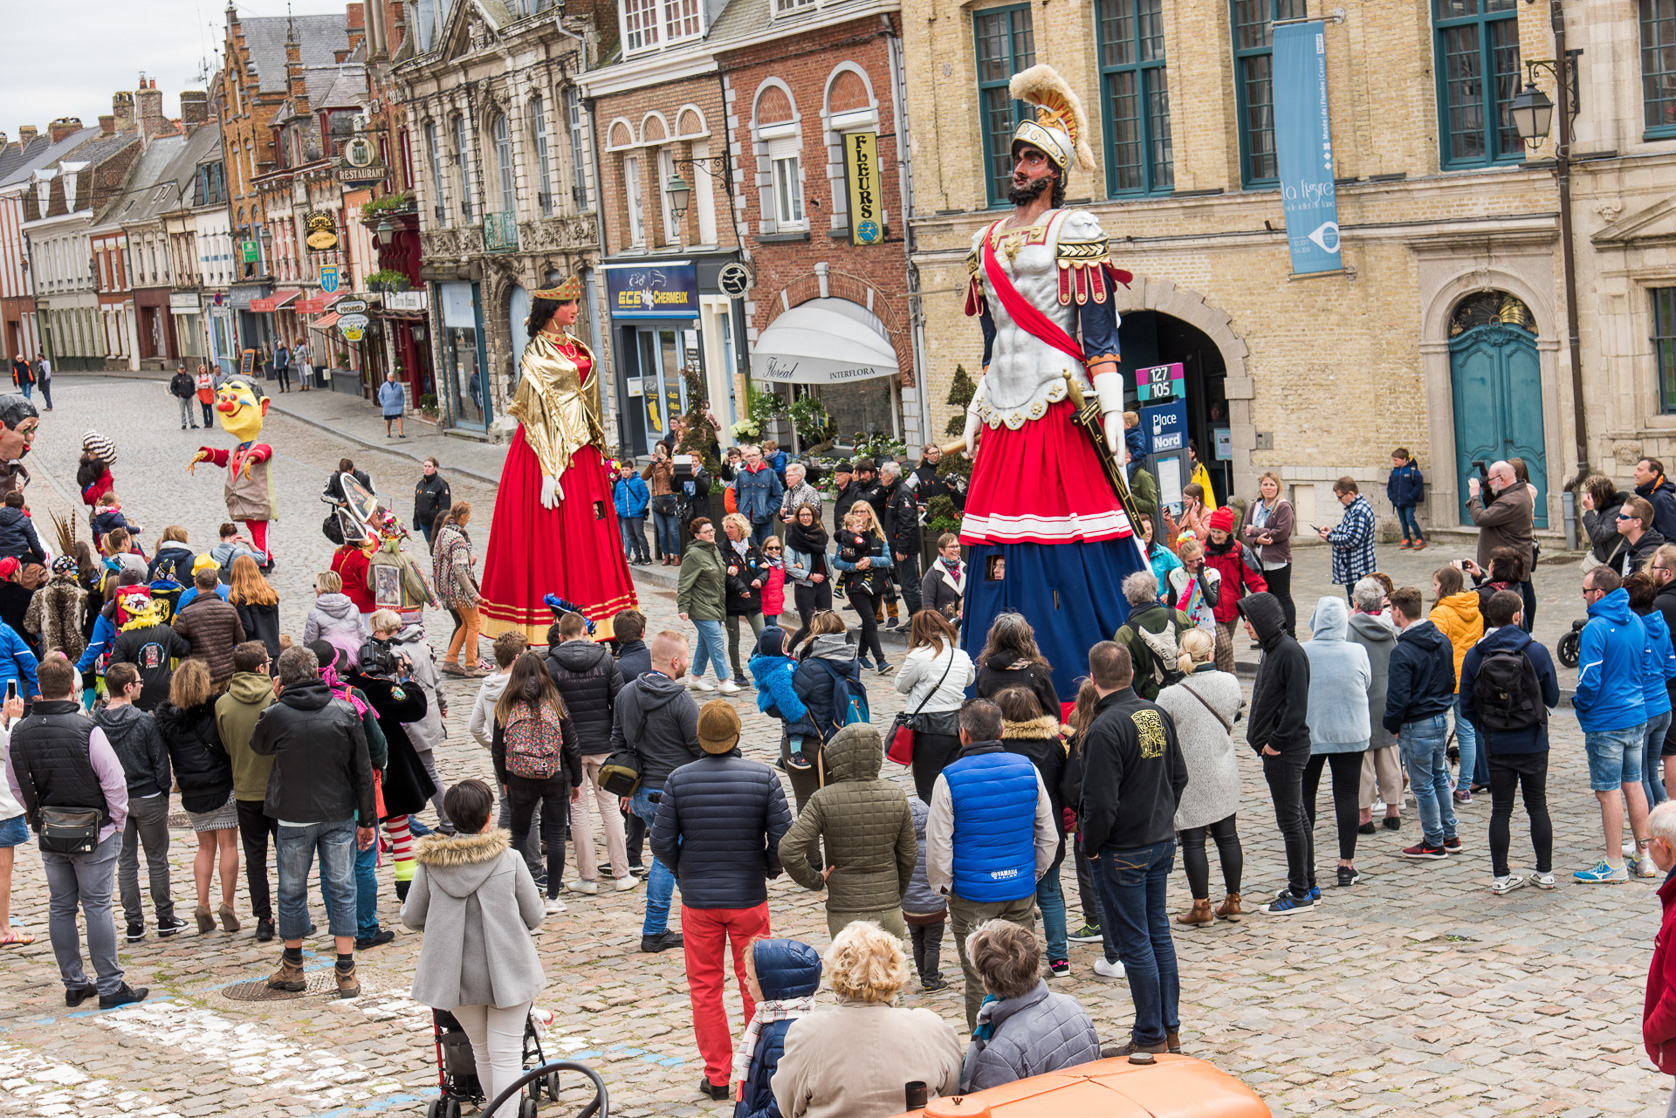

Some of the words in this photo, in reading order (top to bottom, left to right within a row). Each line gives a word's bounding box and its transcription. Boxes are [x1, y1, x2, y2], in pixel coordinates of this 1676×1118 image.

[339, 168, 385, 180] RESTAURANT
[855, 135, 873, 219] FLEURS
[618, 290, 641, 304] ECE
[763, 356, 799, 379] Floréal
[829, 367, 875, 380] INTERFLORA
[1150, 367, 1168, 382] 127
[1152, 382, 1170, 398] 105
[1152, 414, 1177, 427] Place
[1154, 433, 1180, 449] Nord
[997, 869, 1018, 877] YAMAHA
